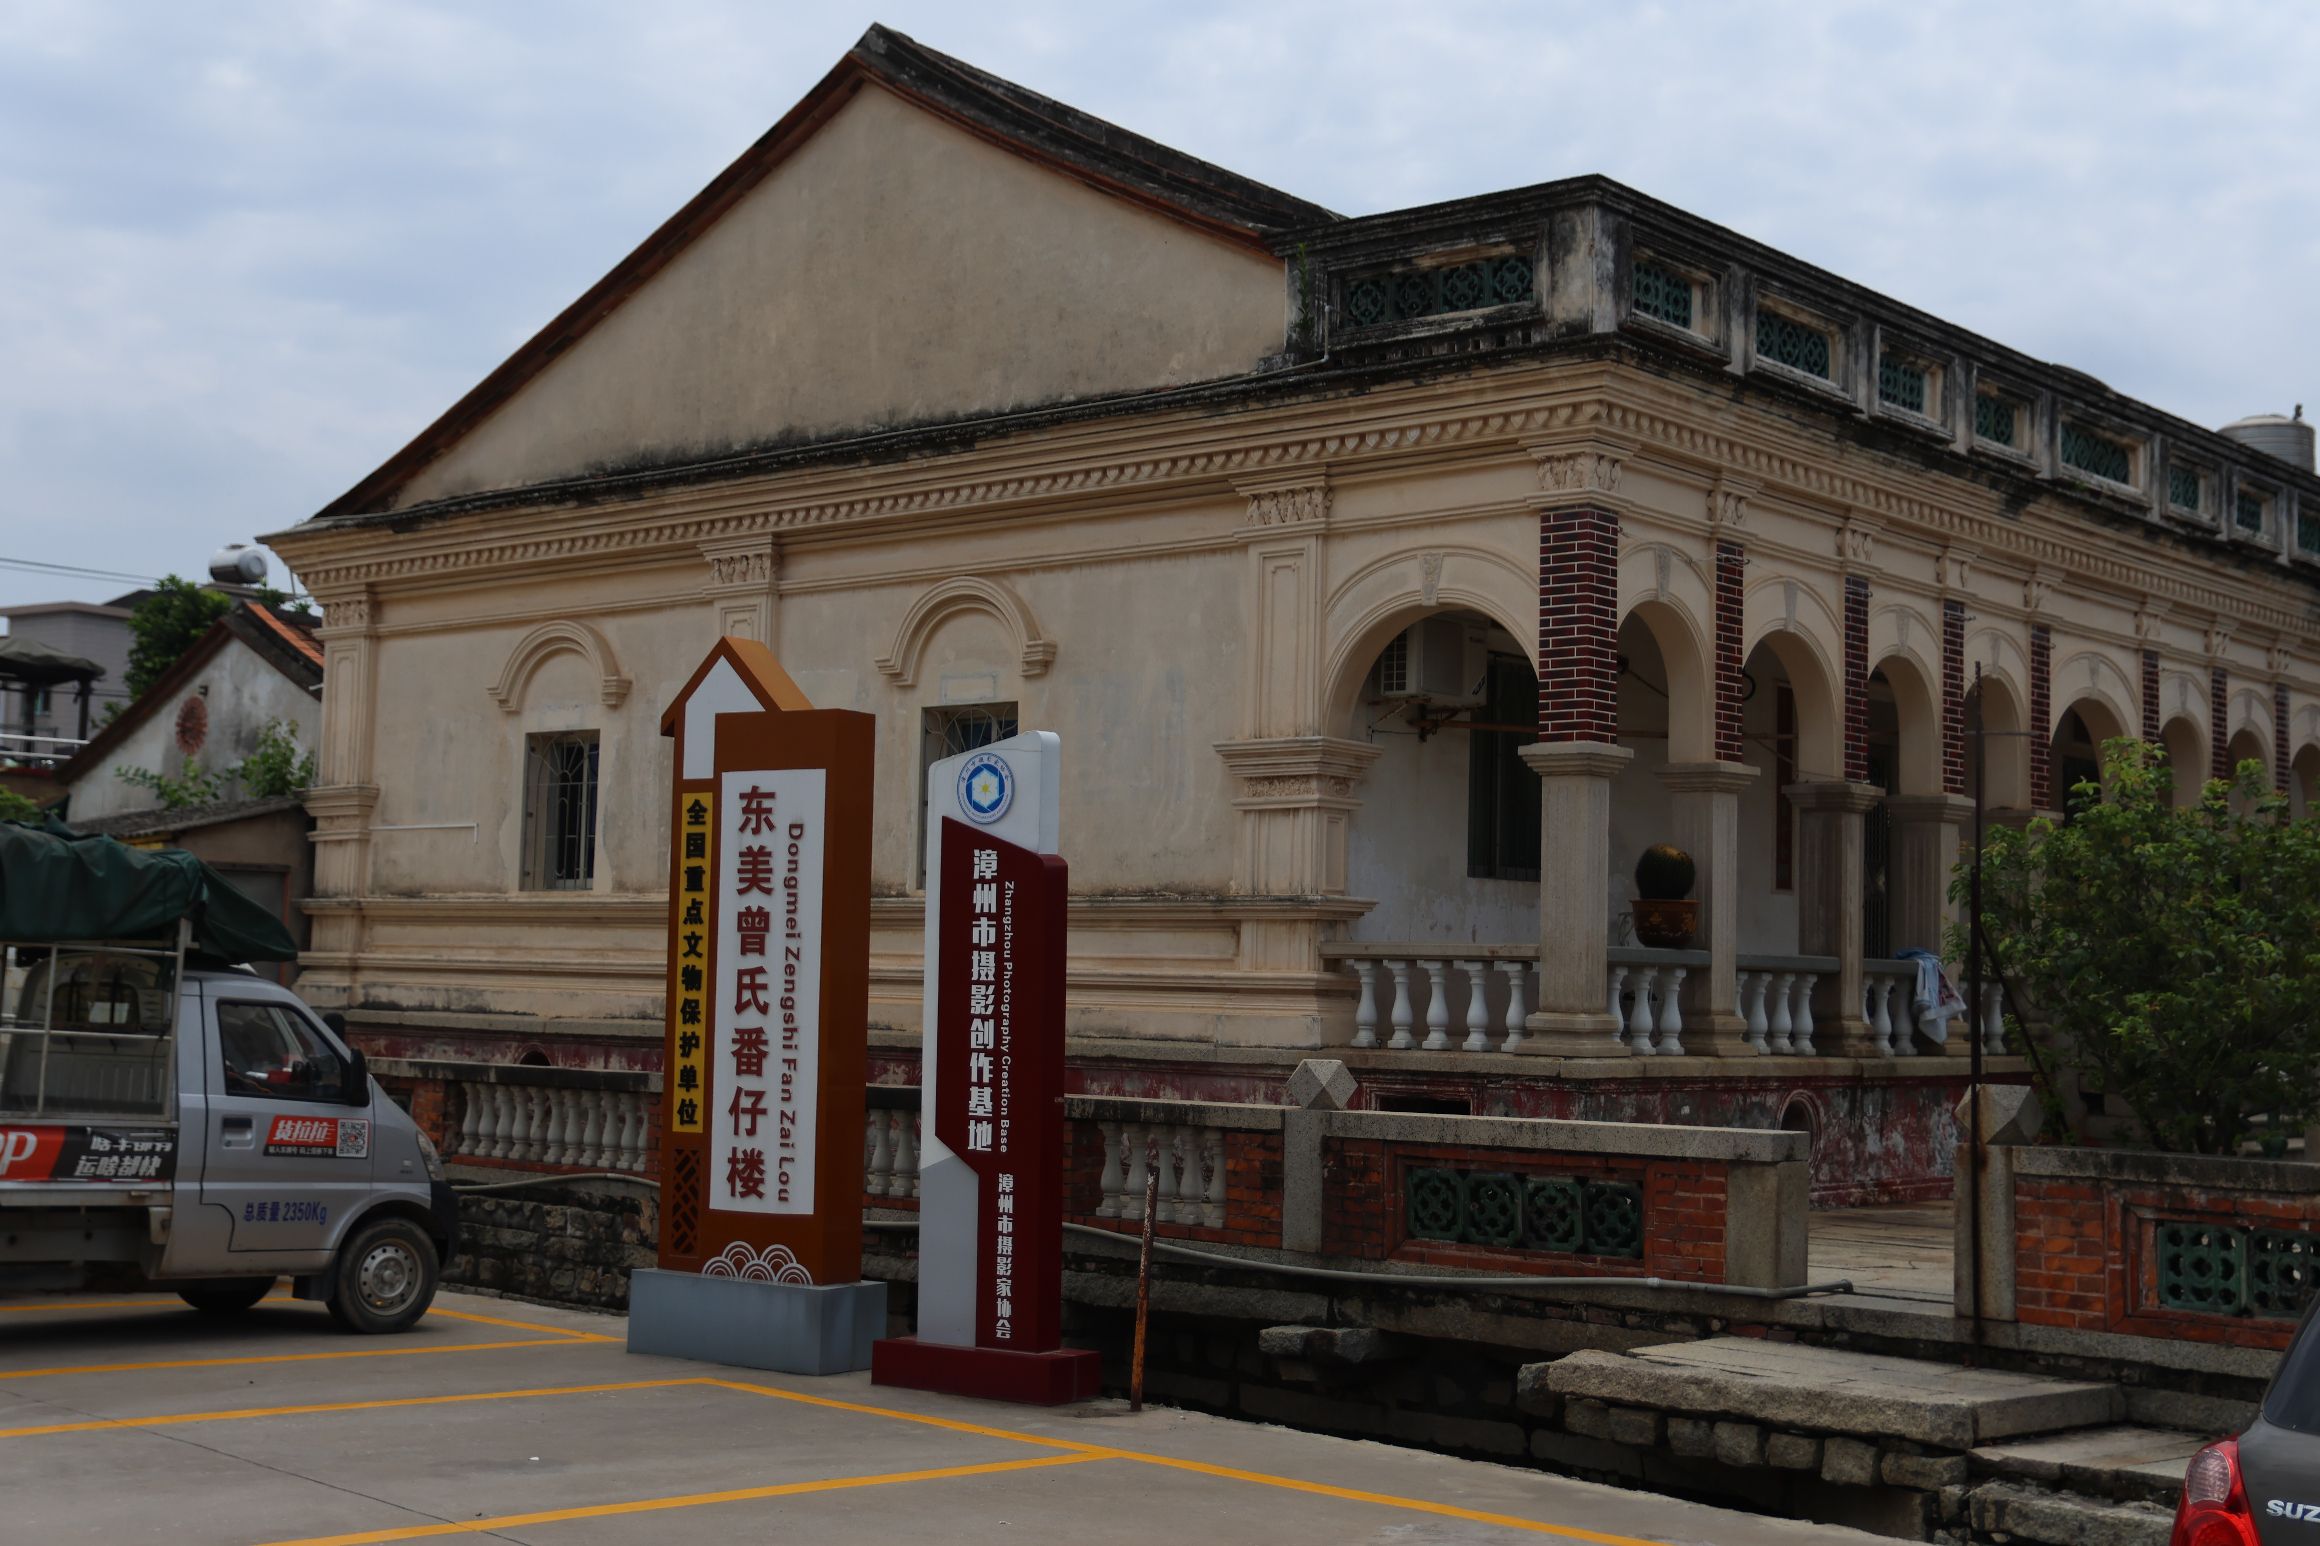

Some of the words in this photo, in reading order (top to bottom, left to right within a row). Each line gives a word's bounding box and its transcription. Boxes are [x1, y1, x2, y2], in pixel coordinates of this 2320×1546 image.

[782, 822, 804, 939] Dongmei
[1002, 880, 1015, 958] Zhangzhou
[676, 798, 709, 1126] 全国重点文物保护单位
[726, 785, 777, 1200] 东美曾氏番仔楼
[780, 946, 801, 1051] Zengshi
[967, 849, 998, 1152] 漳州市摄影创作基地
[1000, 962, 1013, 1053] Photography
[780, 1058, 798, 1103] Fan
[1000, 1056, 1012, 1116] Creation
[74, 1155, 162, 1177] 运啥都快
[779, 1109, 796, 1149] Zai
[1000, 1119, 1010, 1153] Base
[243, 1201, 280, 1222] 总质量
[282, 1201, 328, 1226] 2350Kg
[777, 1156, 795, 1204] Lou
[995, 1172, 1014, 1339] 漳州市摄影家协会
